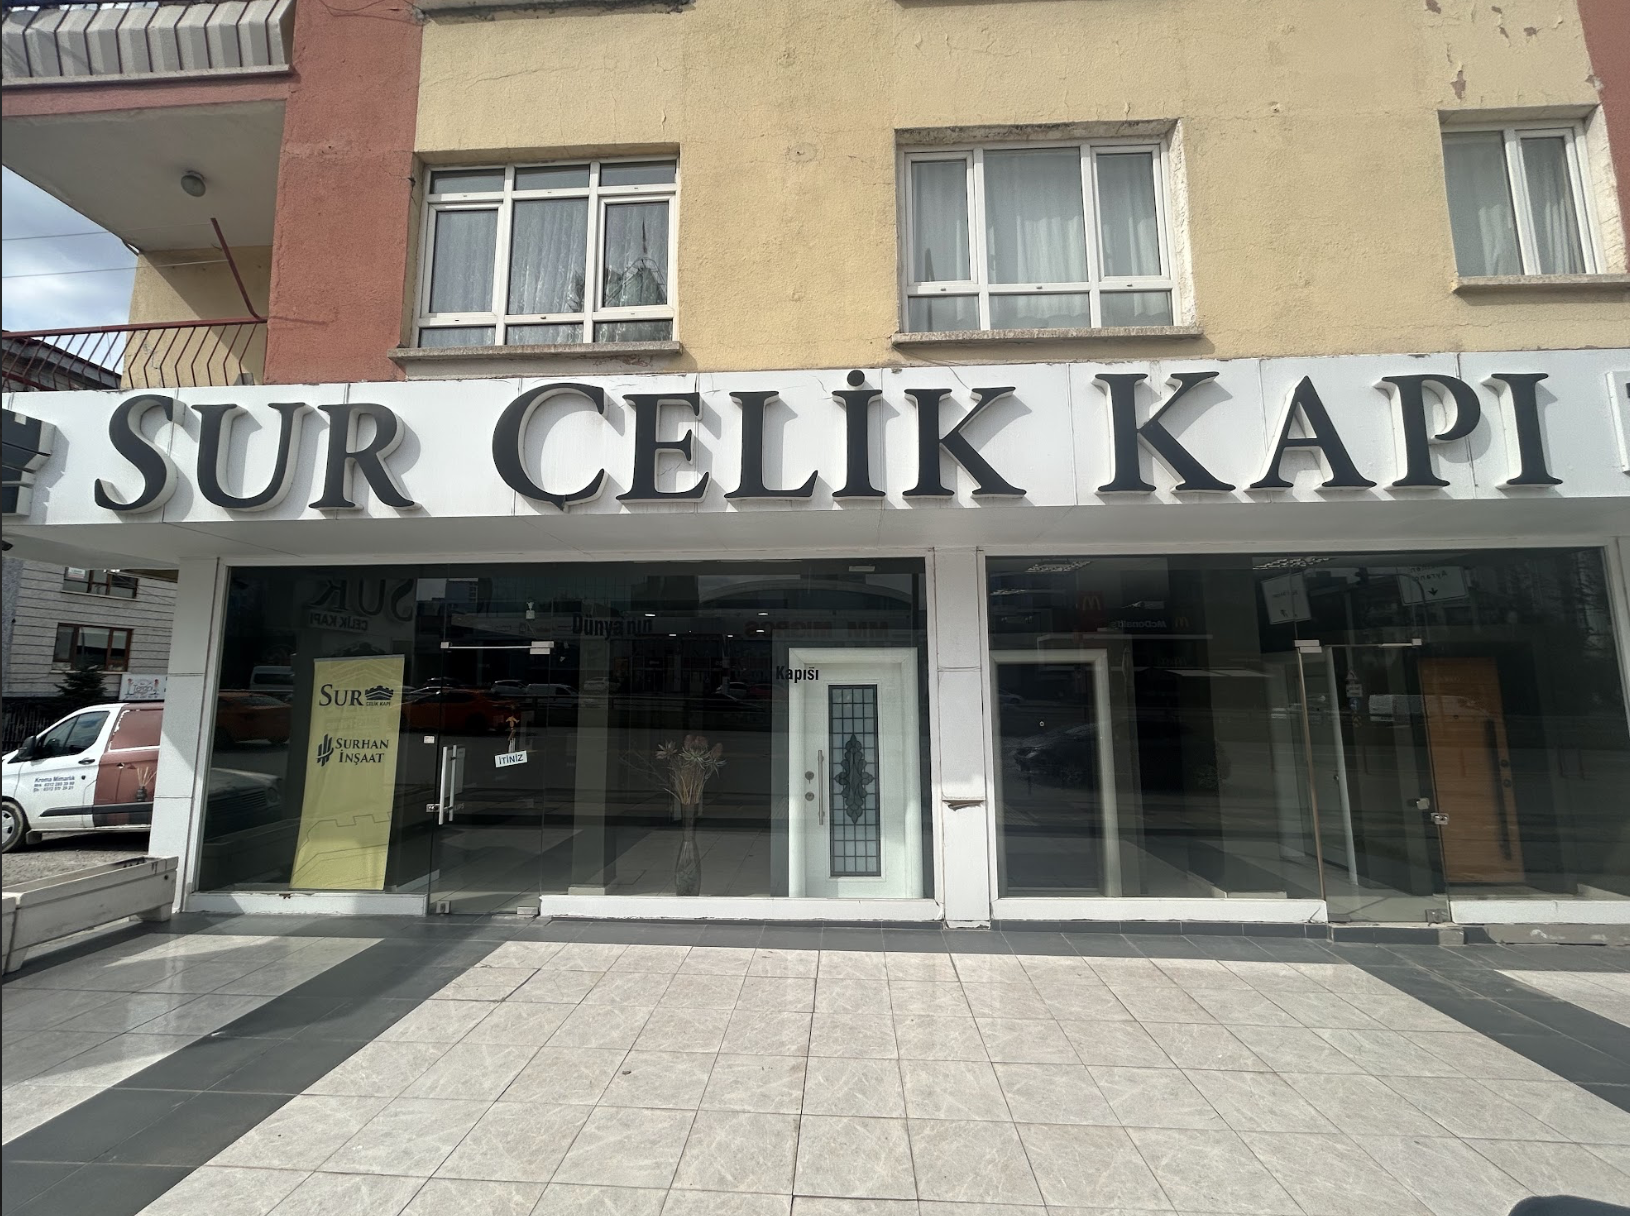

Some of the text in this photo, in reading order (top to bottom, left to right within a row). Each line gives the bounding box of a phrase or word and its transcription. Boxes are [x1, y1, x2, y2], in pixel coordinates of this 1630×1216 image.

[94, 394, 415, 511] SUR
[1094, 371, 1563, 492] KAPI
[319, 684, 363, 706] SUR
[335, 737, 389, 750] SURHAN
[338, 749, 385, 766] İNŞAAT
